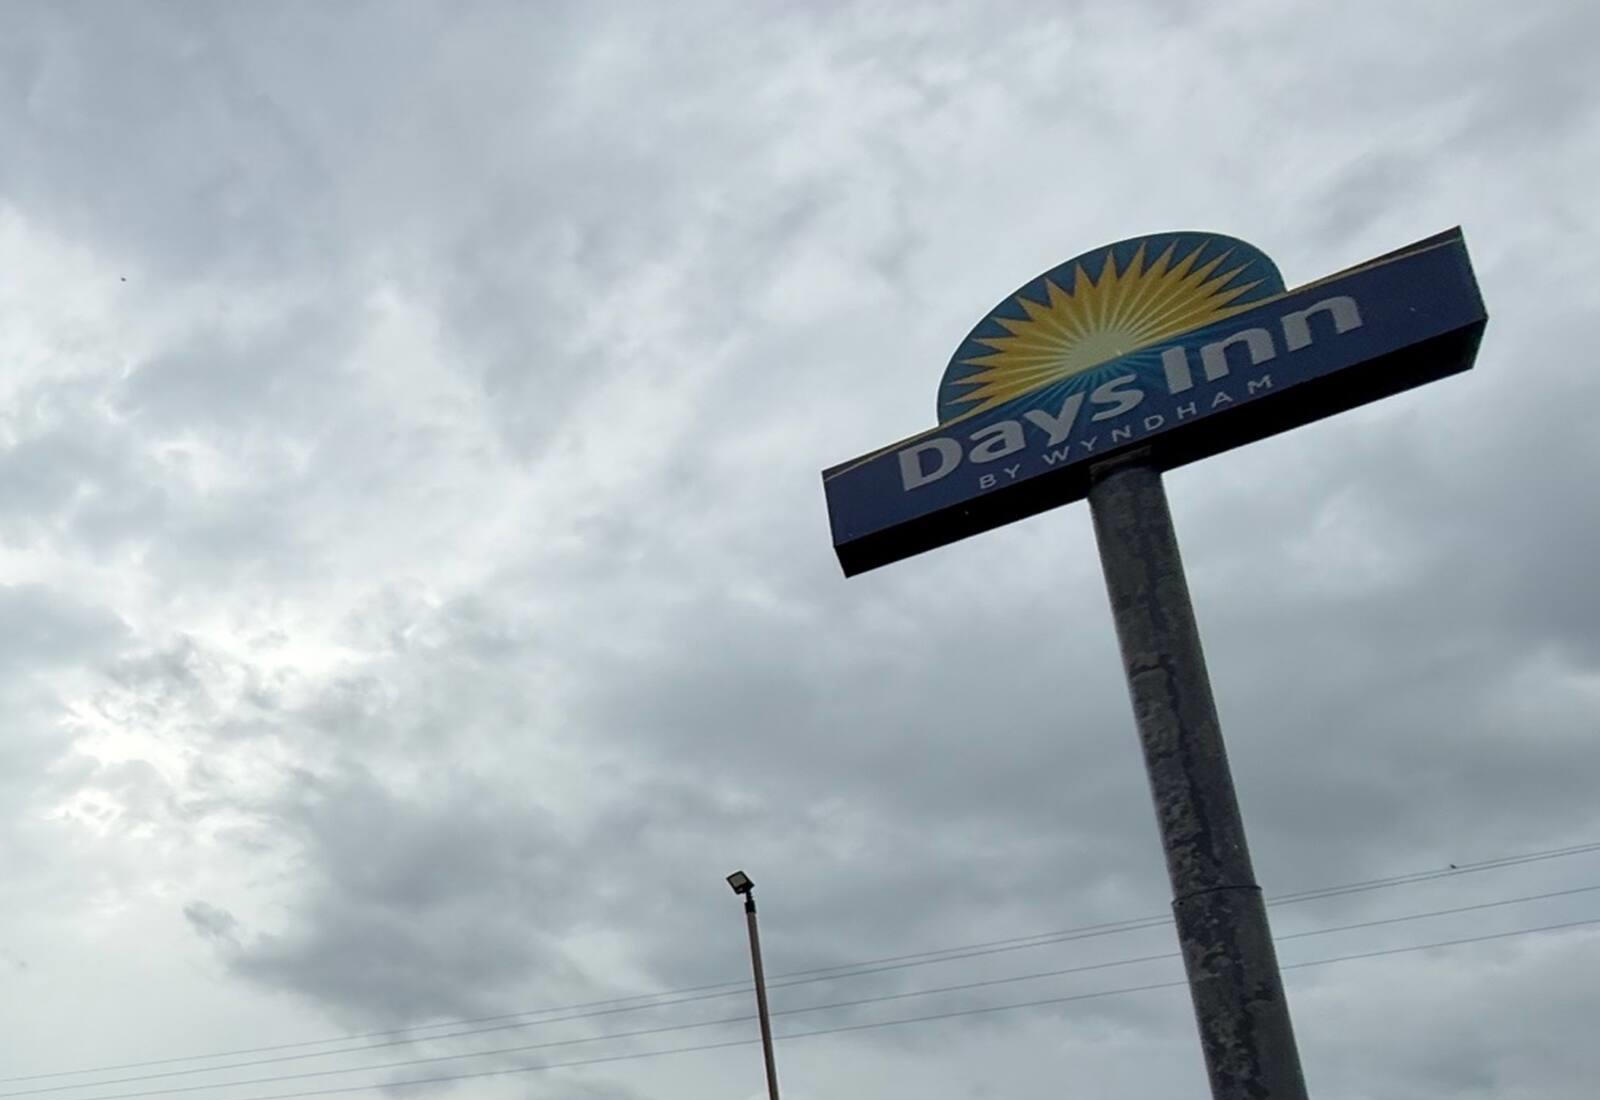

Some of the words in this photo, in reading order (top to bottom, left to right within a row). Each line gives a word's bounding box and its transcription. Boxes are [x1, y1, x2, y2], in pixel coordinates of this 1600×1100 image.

[900, 374, 1144, 491] Days
[1161, 296, 1362, 394] Inn
[979, 464, 1021, 489] BY
[1042, 374, 1274, 466] WYNDHAM
